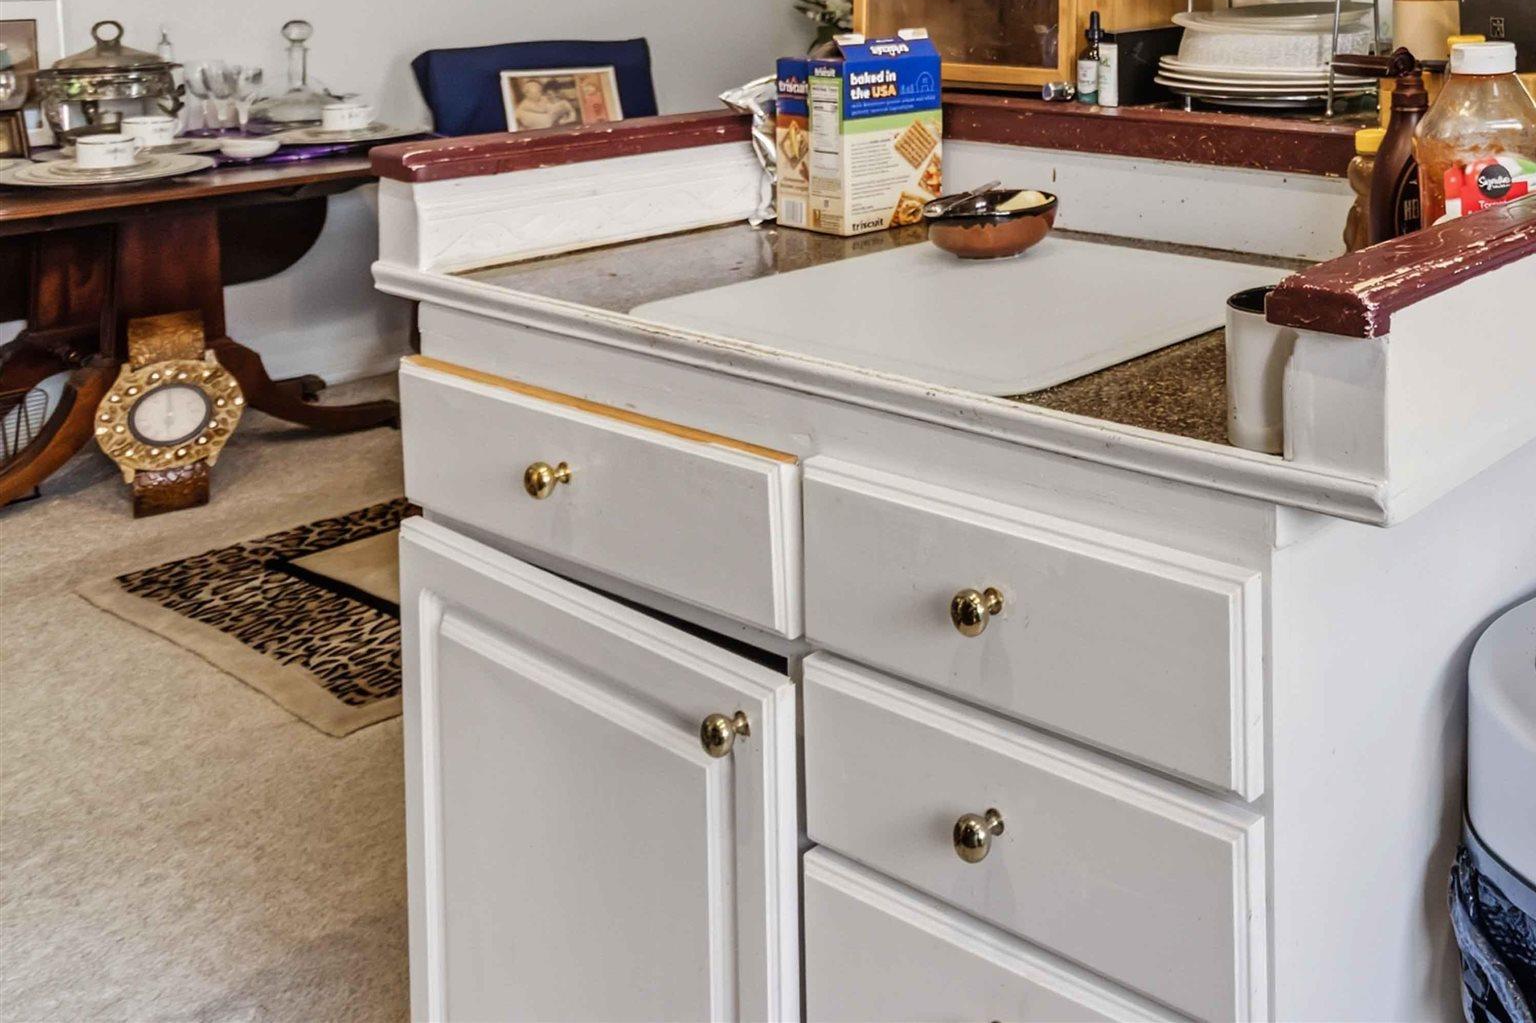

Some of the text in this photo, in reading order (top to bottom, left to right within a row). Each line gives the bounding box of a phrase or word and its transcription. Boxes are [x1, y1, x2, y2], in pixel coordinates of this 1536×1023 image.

[850, 70, 885, 86] baked
[885, 69, 897, 83] in
[850, 86, 871, 101] the
[871, 83, 897, 98] USA
[851, 217, 885, 232] triscuit
